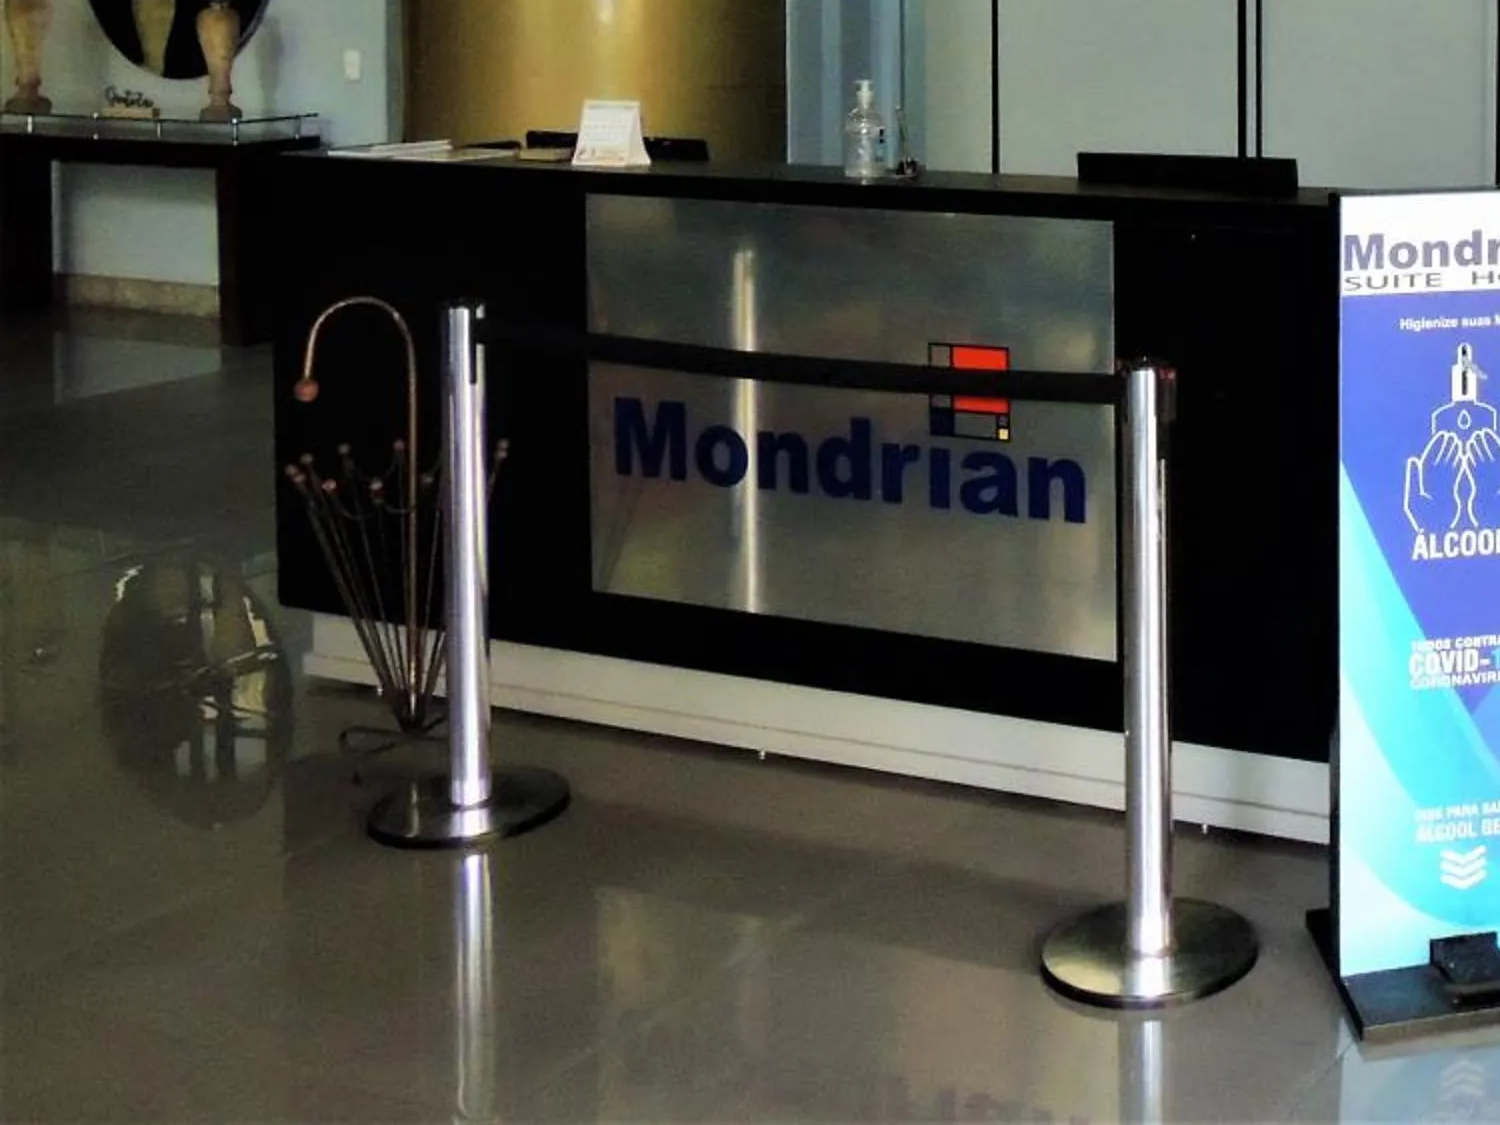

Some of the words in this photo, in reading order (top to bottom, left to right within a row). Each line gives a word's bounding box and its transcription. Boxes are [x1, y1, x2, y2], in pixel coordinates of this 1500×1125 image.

[1344, 272, 1442, 291] SUITE
[1399, 316, 1459, 331] Higienize
[1461, 315, 1492, 328] suas
[613, 395, 1086, 524] Mondrian
